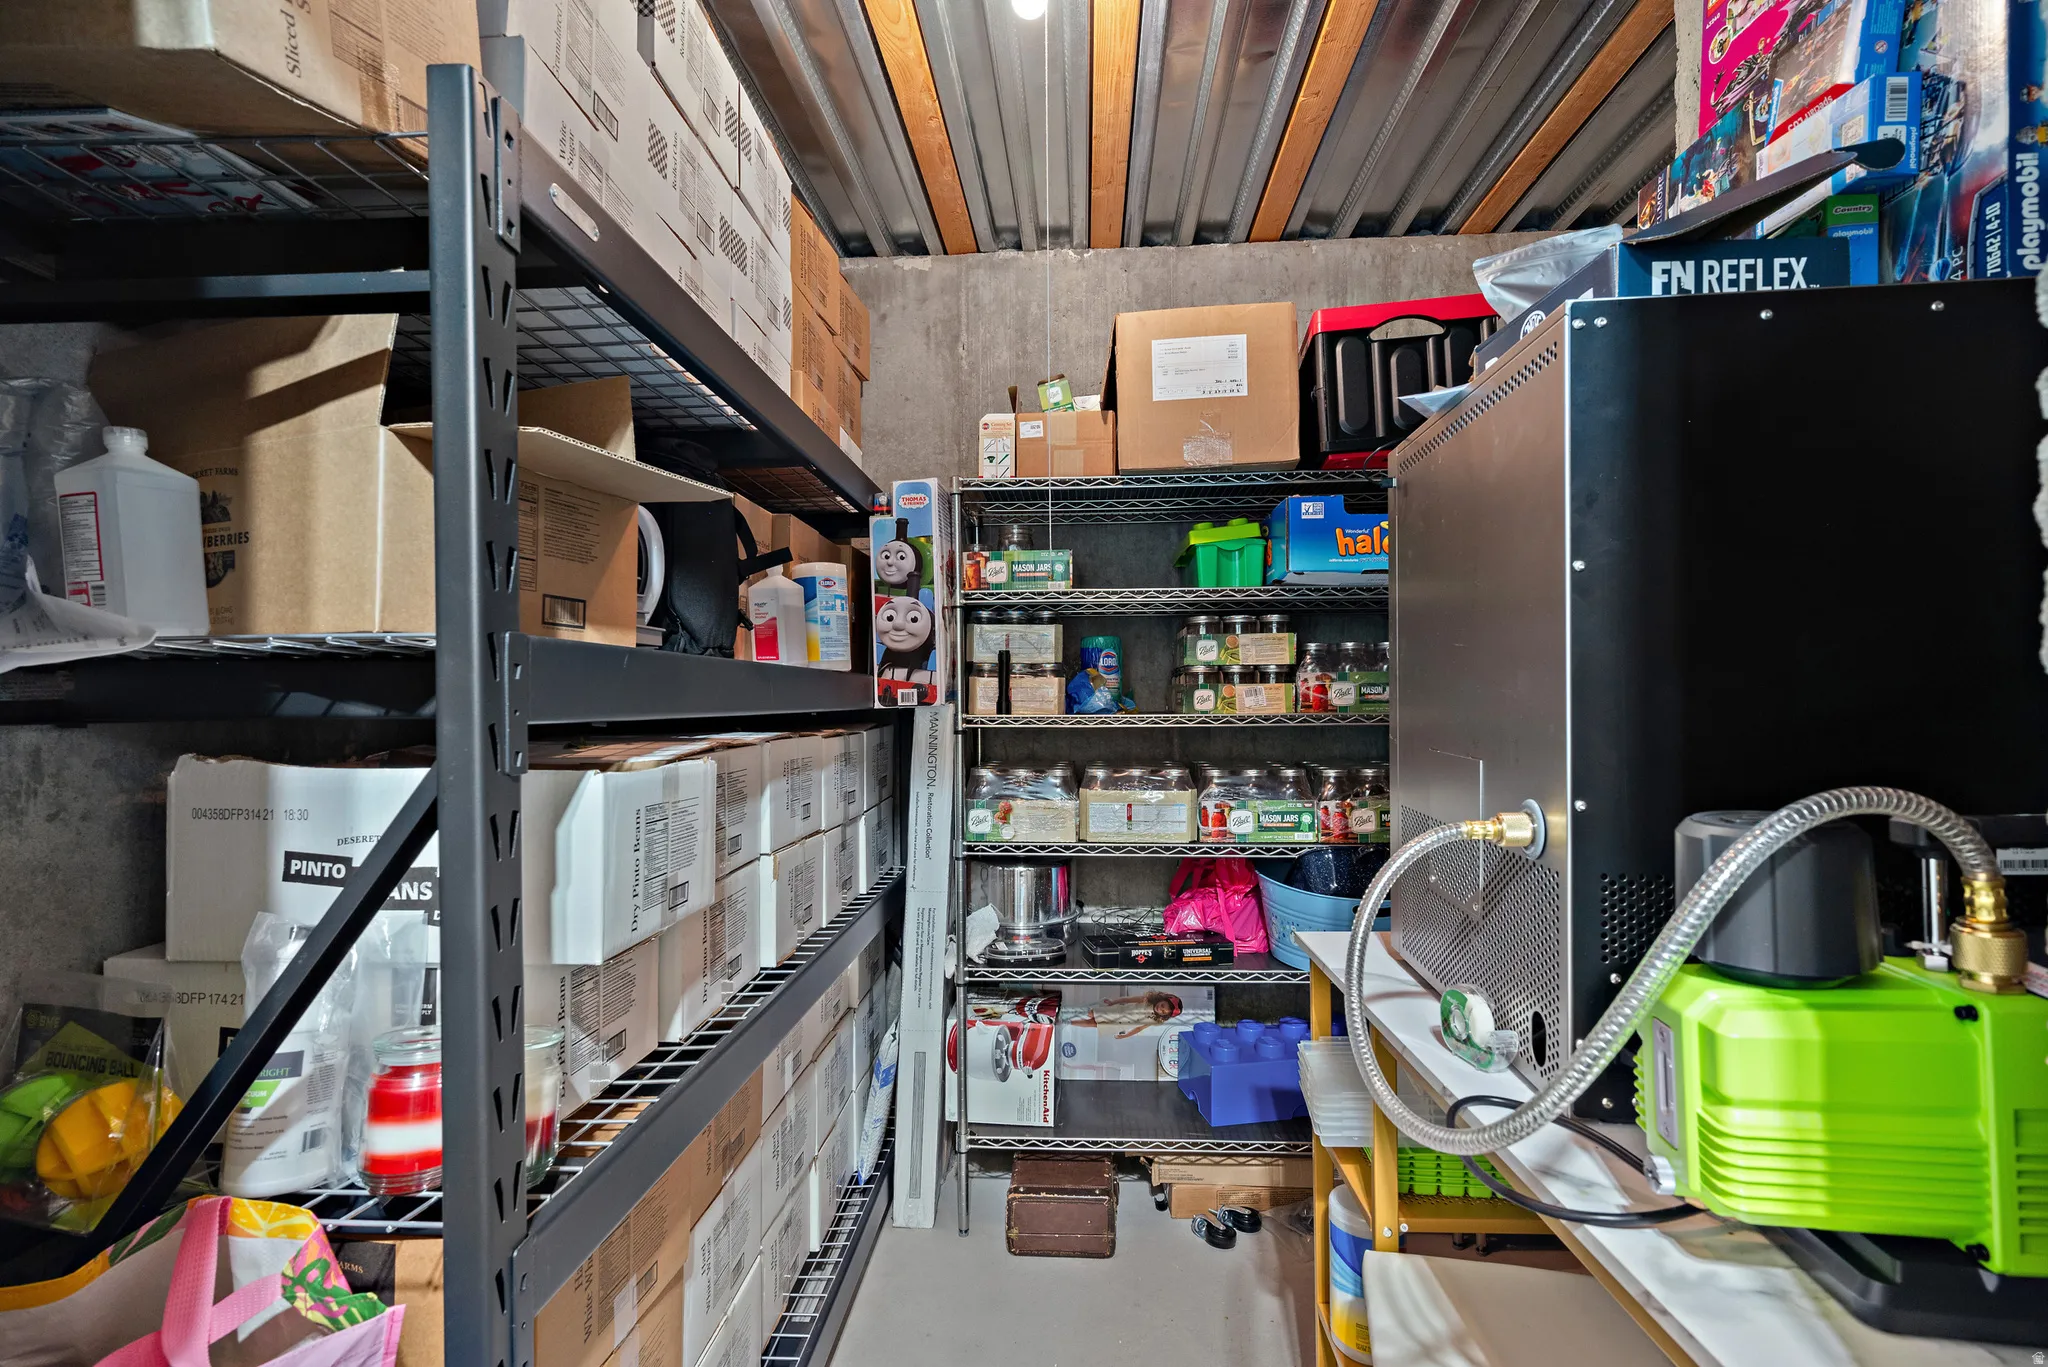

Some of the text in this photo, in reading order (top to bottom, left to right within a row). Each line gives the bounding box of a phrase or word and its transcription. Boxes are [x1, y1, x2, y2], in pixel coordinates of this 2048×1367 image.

[280, 8, 302, 78] Sliced
[552, 3, 563, 79] Granulated
[1909, 126, 1918, 169] playmobil
[1832, 204, 1874, 214] Country
[2015, 152, 2046, 271] playmobil
[1651, 260, 1696, 296] FN
[1702, 256, 1808, 294] REFLEX
[901, 495, 927, 503] THOMAS
[988, 565, 1005, 577] Ball
[1012, 563, 1052, 572] MASON JARS
[1198, 644, 1216, 657] Ball
[1333, 686, 1353, 699] Ball
[1360, 686, 1384, 694] MASON
[1196, 694, 1212, 706] Ball
[283, 808, 309, 821] 18:30
[925, 792, 934, 827] Restoration
[970, 815, 989, 827] Ball
[1232, 816, 1251, 827] Ball
[1260, 814, 1299, 823] MASON JARS
[1353, 816, 1373, 827] Ball
[290, 859, 347, 879] PINTO
[631, 808, 641, 933] Dry Pinto Beans
[45, 1051, 139, 1078] BOUNCING BALL
[1042, 1070, 1050, 1123] KitchenAid
[338, 1260, 364, 1274] ARMS
[584, 1293, 593, 1344] White
